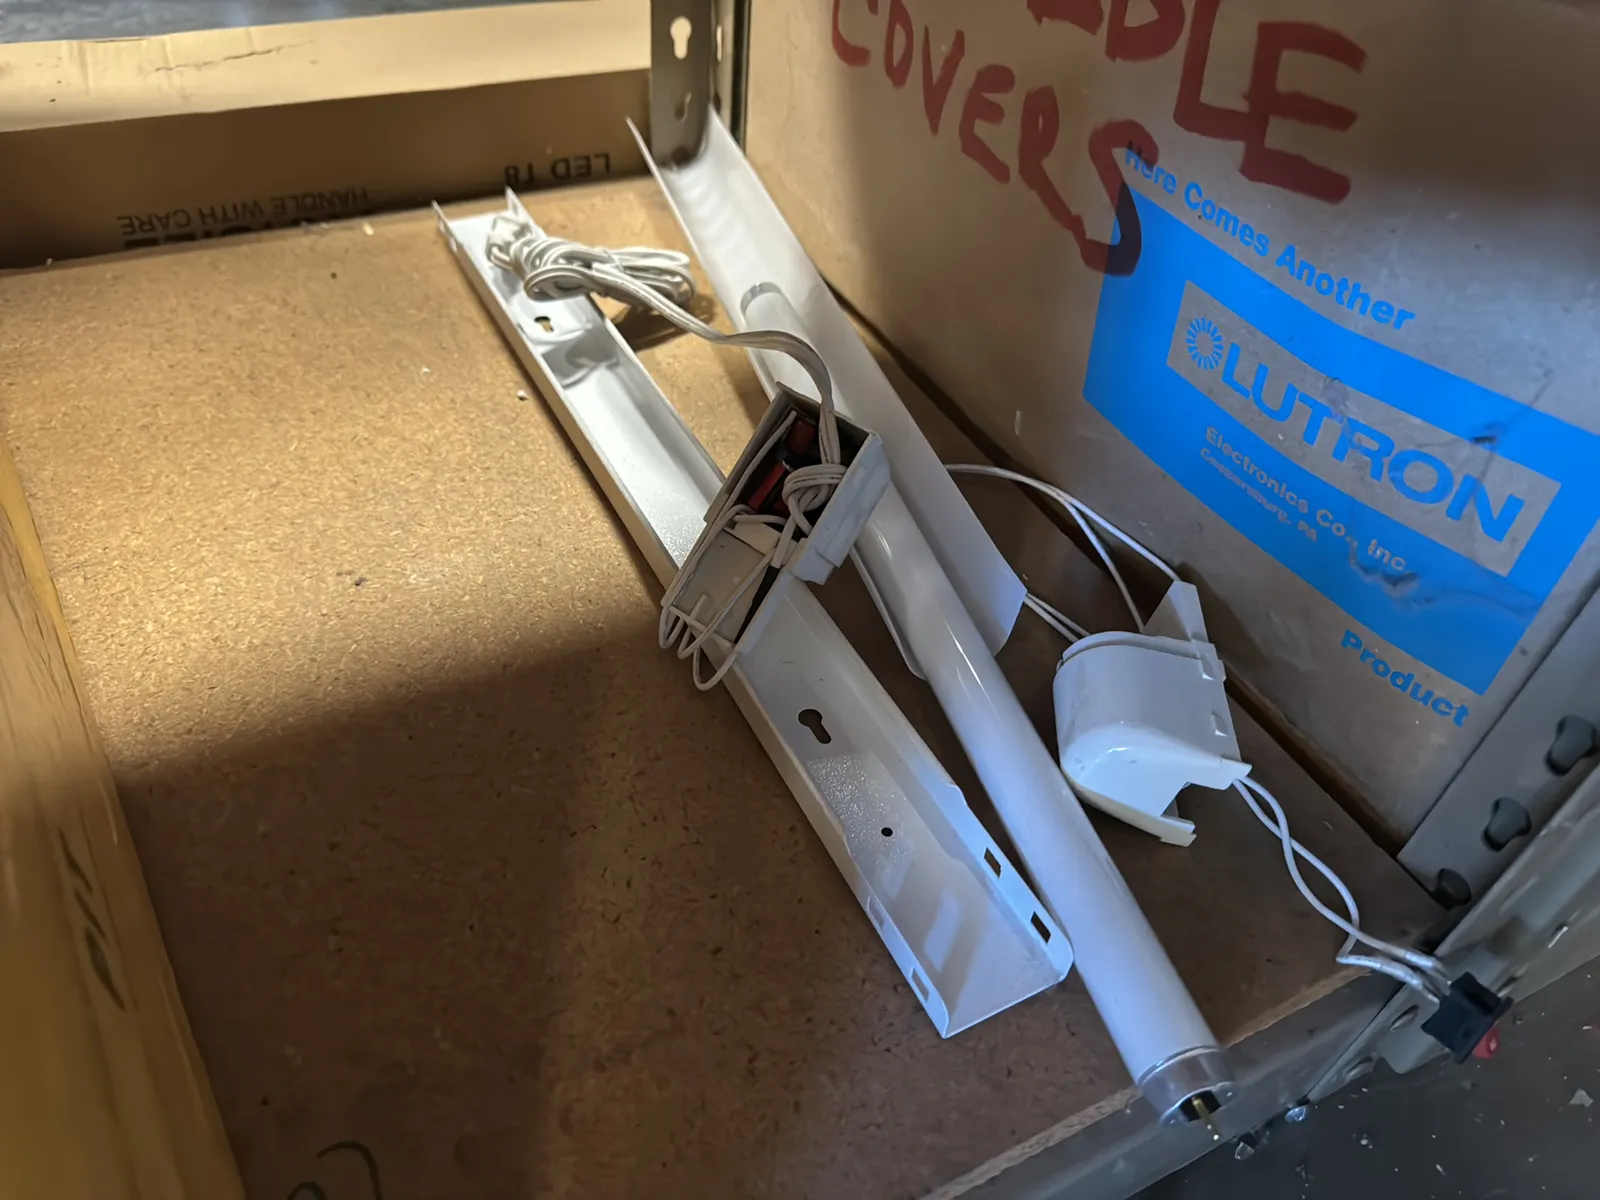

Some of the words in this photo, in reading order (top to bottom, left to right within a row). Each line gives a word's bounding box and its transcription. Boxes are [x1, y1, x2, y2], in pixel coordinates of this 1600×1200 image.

[550, 152, 611, 180] LED
[831, 0, 1160, 277] COVERS
[116, 208, 191, 236] CARE
[198, 202, 265, 227] WITH
[269, 187, 369, 214] HANDLE
[1184, 181, 1270, 257] Comes
[1276, 244, 1416, 330] Another
[1221, 343, 1525, 542] LUTRON
[1340, 628, 1470, 729] Product
